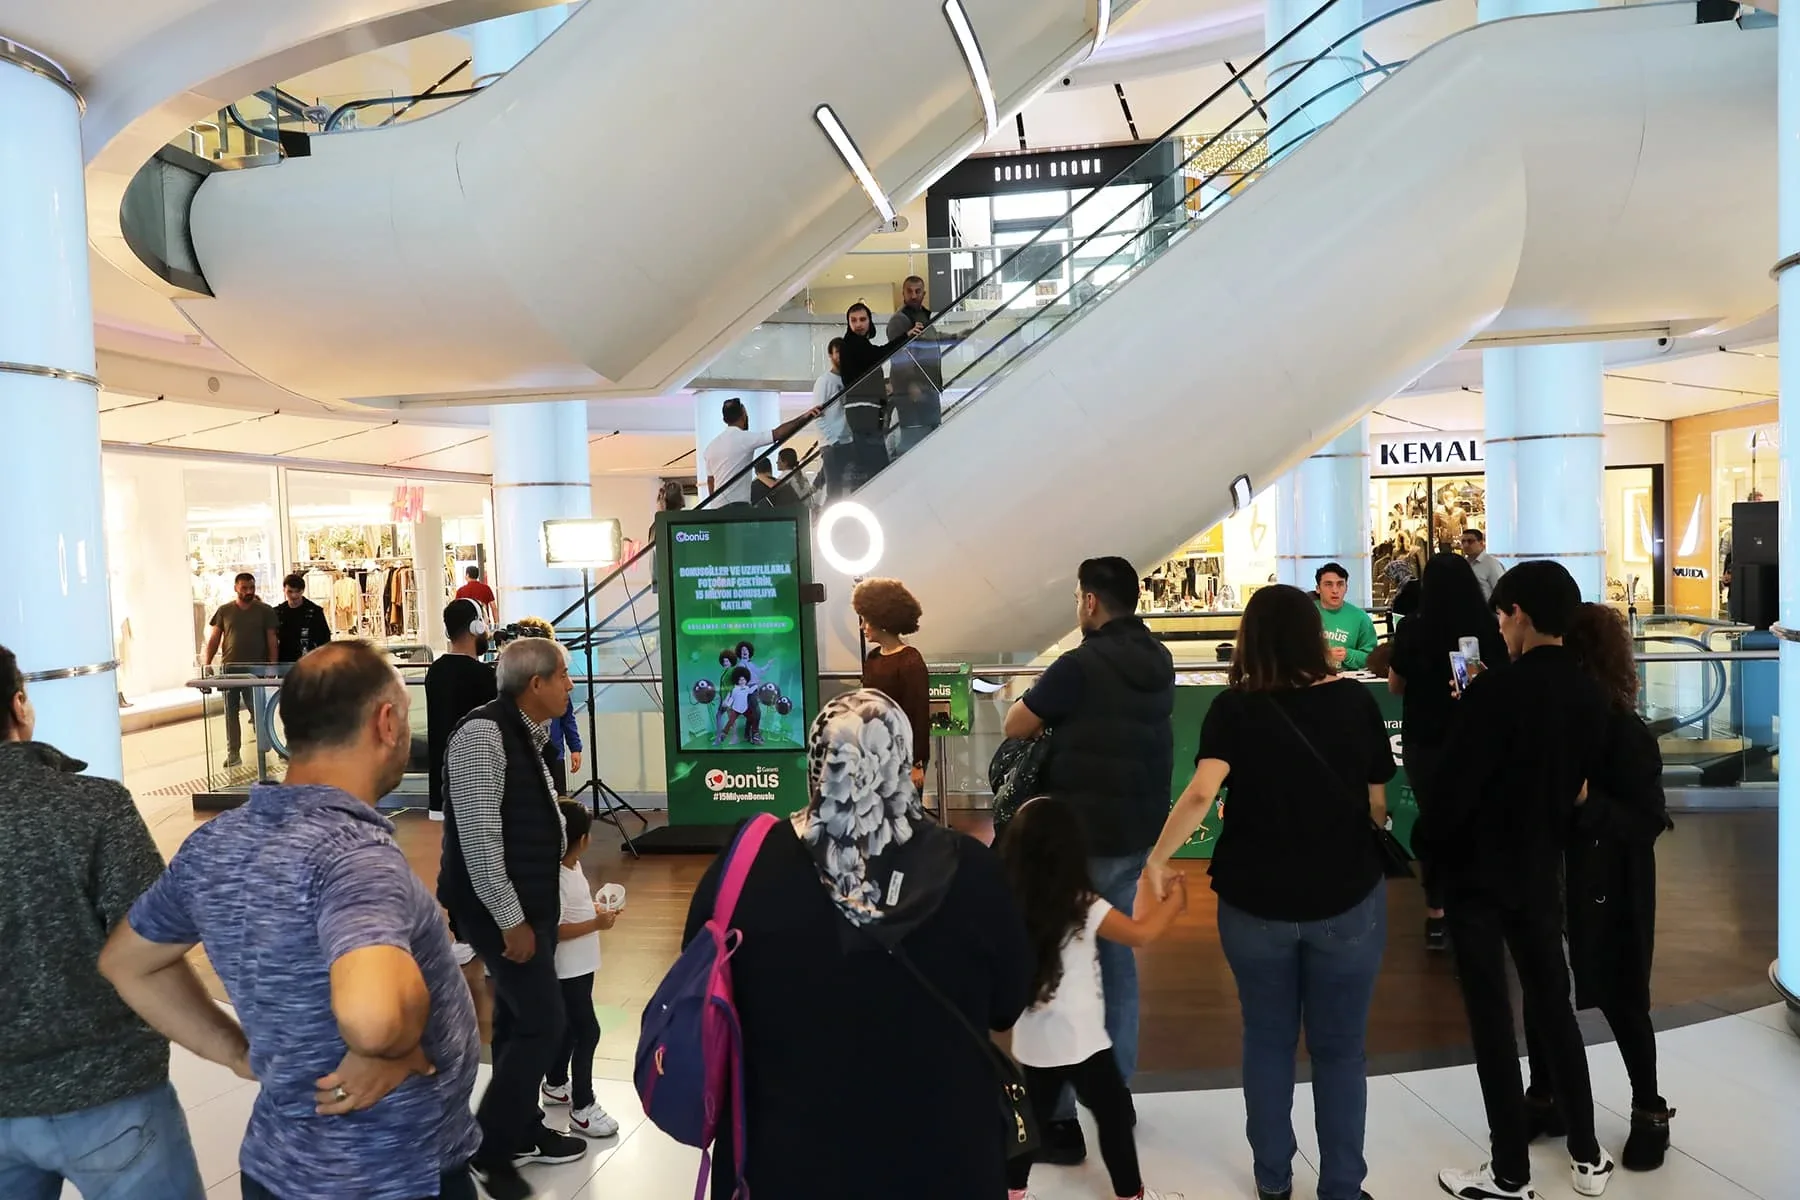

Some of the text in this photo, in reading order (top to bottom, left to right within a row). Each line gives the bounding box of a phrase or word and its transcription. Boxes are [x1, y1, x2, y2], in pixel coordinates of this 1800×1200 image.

[995, 159, 1101, 182] BOBBI BROWN
[1380, 440, 1484, 465] KEMAL
[1323, 631, 1348, 642] onus
[928, 687, 951, 697] onus
[724, 770, 779, 788] bonus
